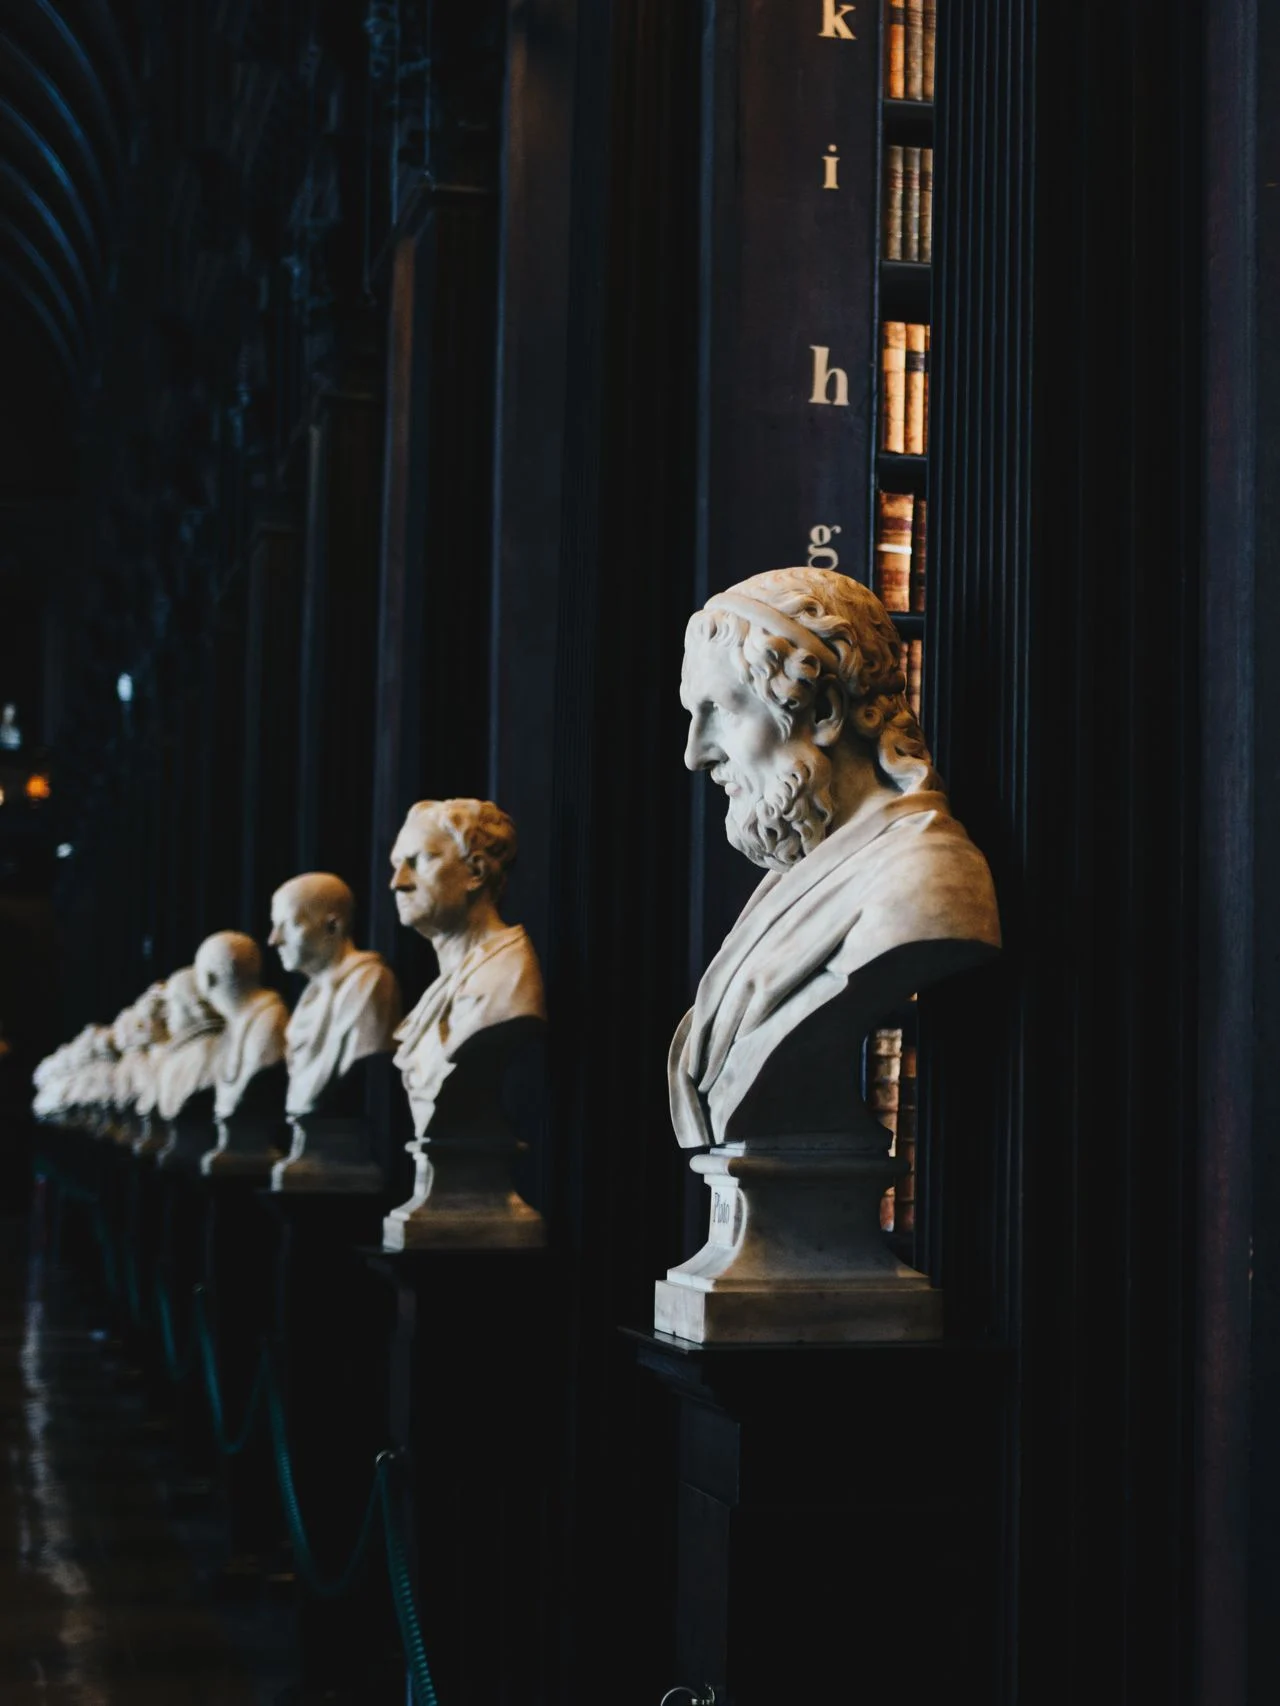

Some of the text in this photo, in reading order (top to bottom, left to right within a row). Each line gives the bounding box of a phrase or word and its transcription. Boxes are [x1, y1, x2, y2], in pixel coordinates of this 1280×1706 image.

[818, 0, 856, 40] k
[822, 144, 839, 189] i
[809, 345, 849, 406] h
[807, 524, 842, 571] g
